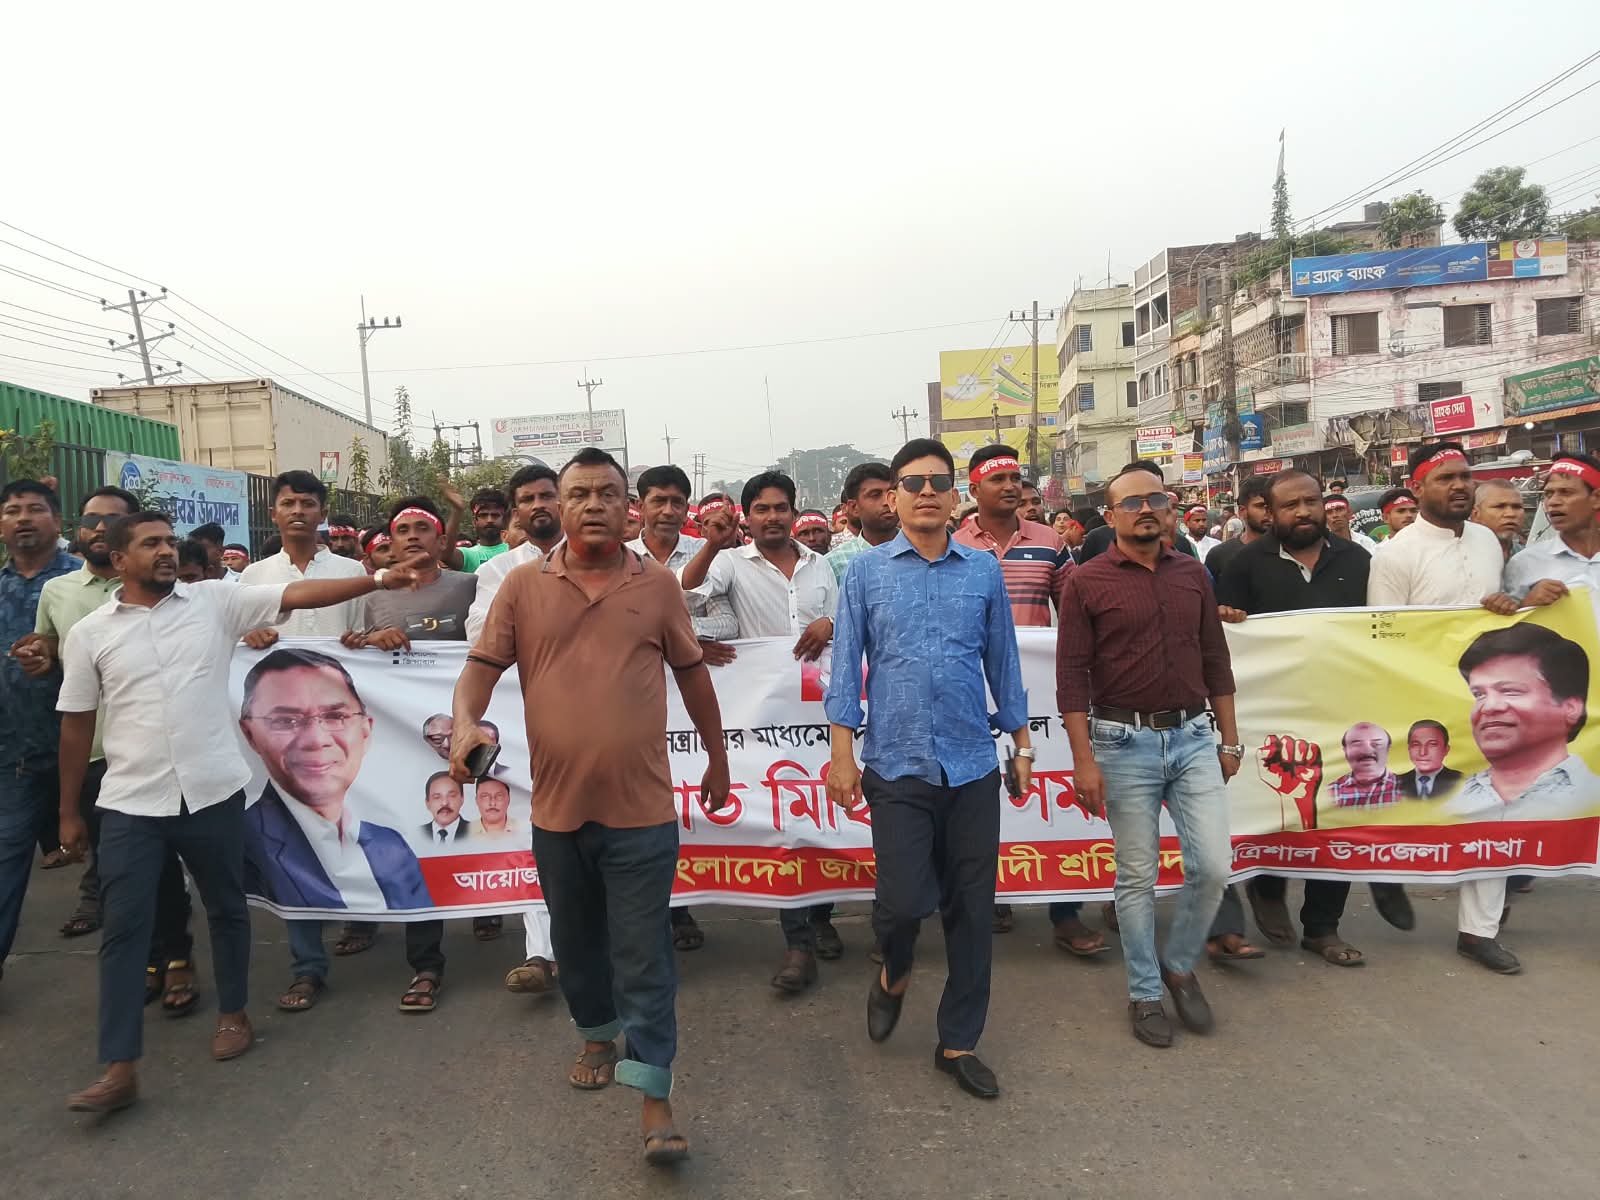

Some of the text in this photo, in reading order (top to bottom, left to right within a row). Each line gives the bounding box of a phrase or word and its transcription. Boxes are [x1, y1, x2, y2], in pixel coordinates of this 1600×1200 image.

[1346, 265, 1386, 281] ব্যাংক
[1137, 427, 1173, 436] UNITED
[675, 856, 807, 887] ংলাদেশ
[1327, 839, 1453, 864] উপজেলা
[1459, 837, 1527, 861] শাখা
